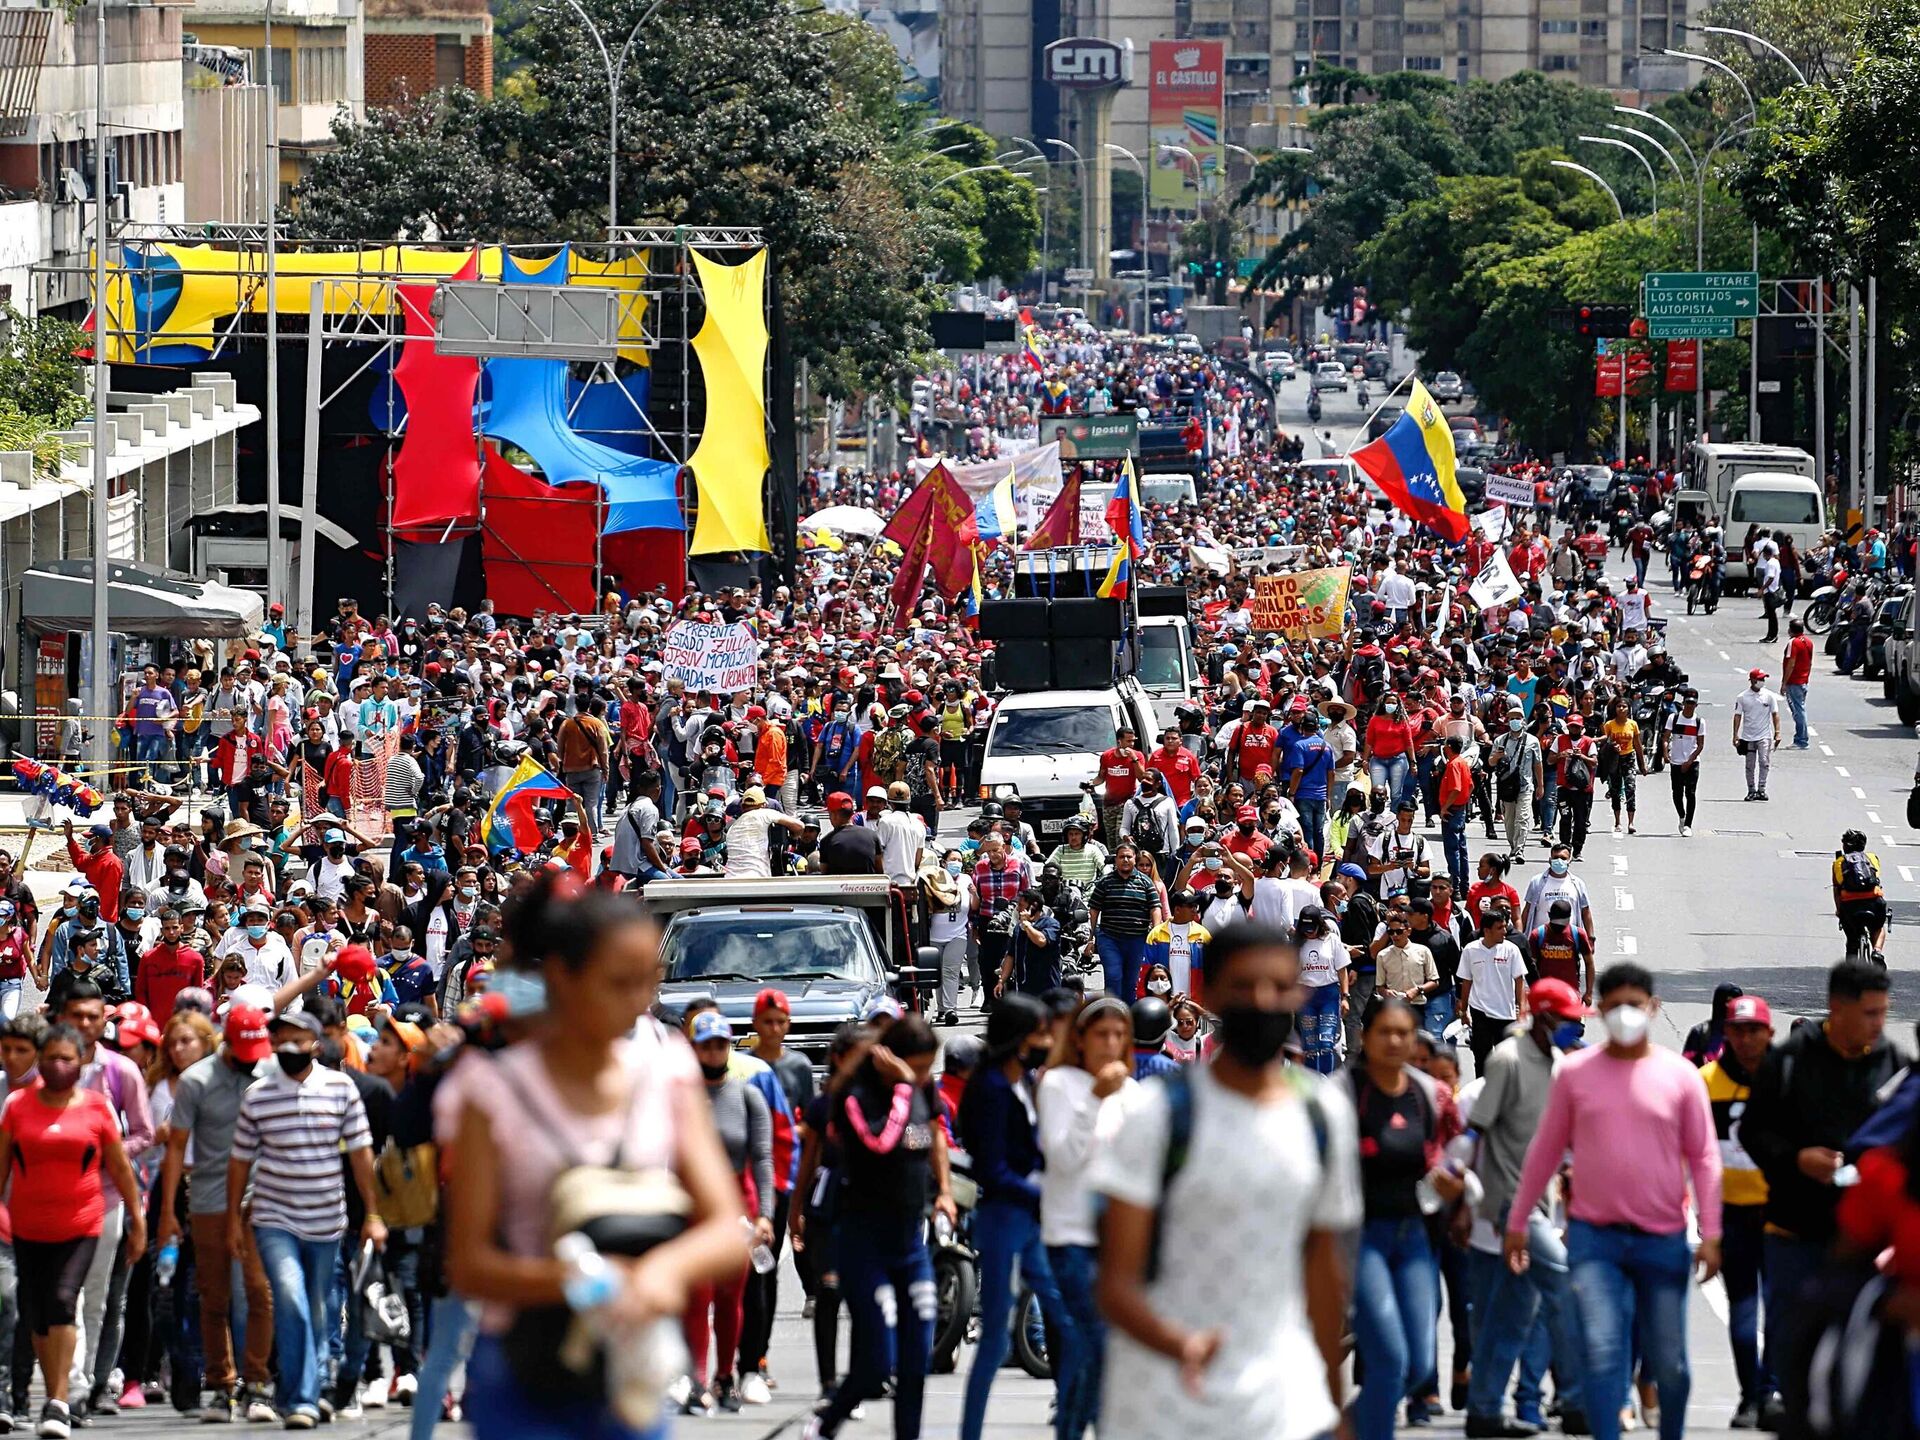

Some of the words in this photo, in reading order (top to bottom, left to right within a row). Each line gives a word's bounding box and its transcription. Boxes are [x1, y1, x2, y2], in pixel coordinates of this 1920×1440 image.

[1156, 71, 1166, 85] EL
[1170, 70, 1217, 85] CASTILLO
[1705, 277, 1750, 286] PETARE
[1651, 291, 1673, 302] LOS
[1676, 291, 1732, 301] CORTIJOS
[1651, 304, 1715, 314] AUTOPISTA
[1653, 327, 1670, 335] LOS
[1672, 326, 1713, 335] CORTIJOS
[1091, 425, 1129, 437] Ipostel
[1488, 476, 1532, 491] Juventud
[1488, 488, 1531, 503] Carvajal
[684, 621, 738, 639] PRESENTE
[667, 630, 704, 652] ESTADO
[704, 674, 717, 686] DE
